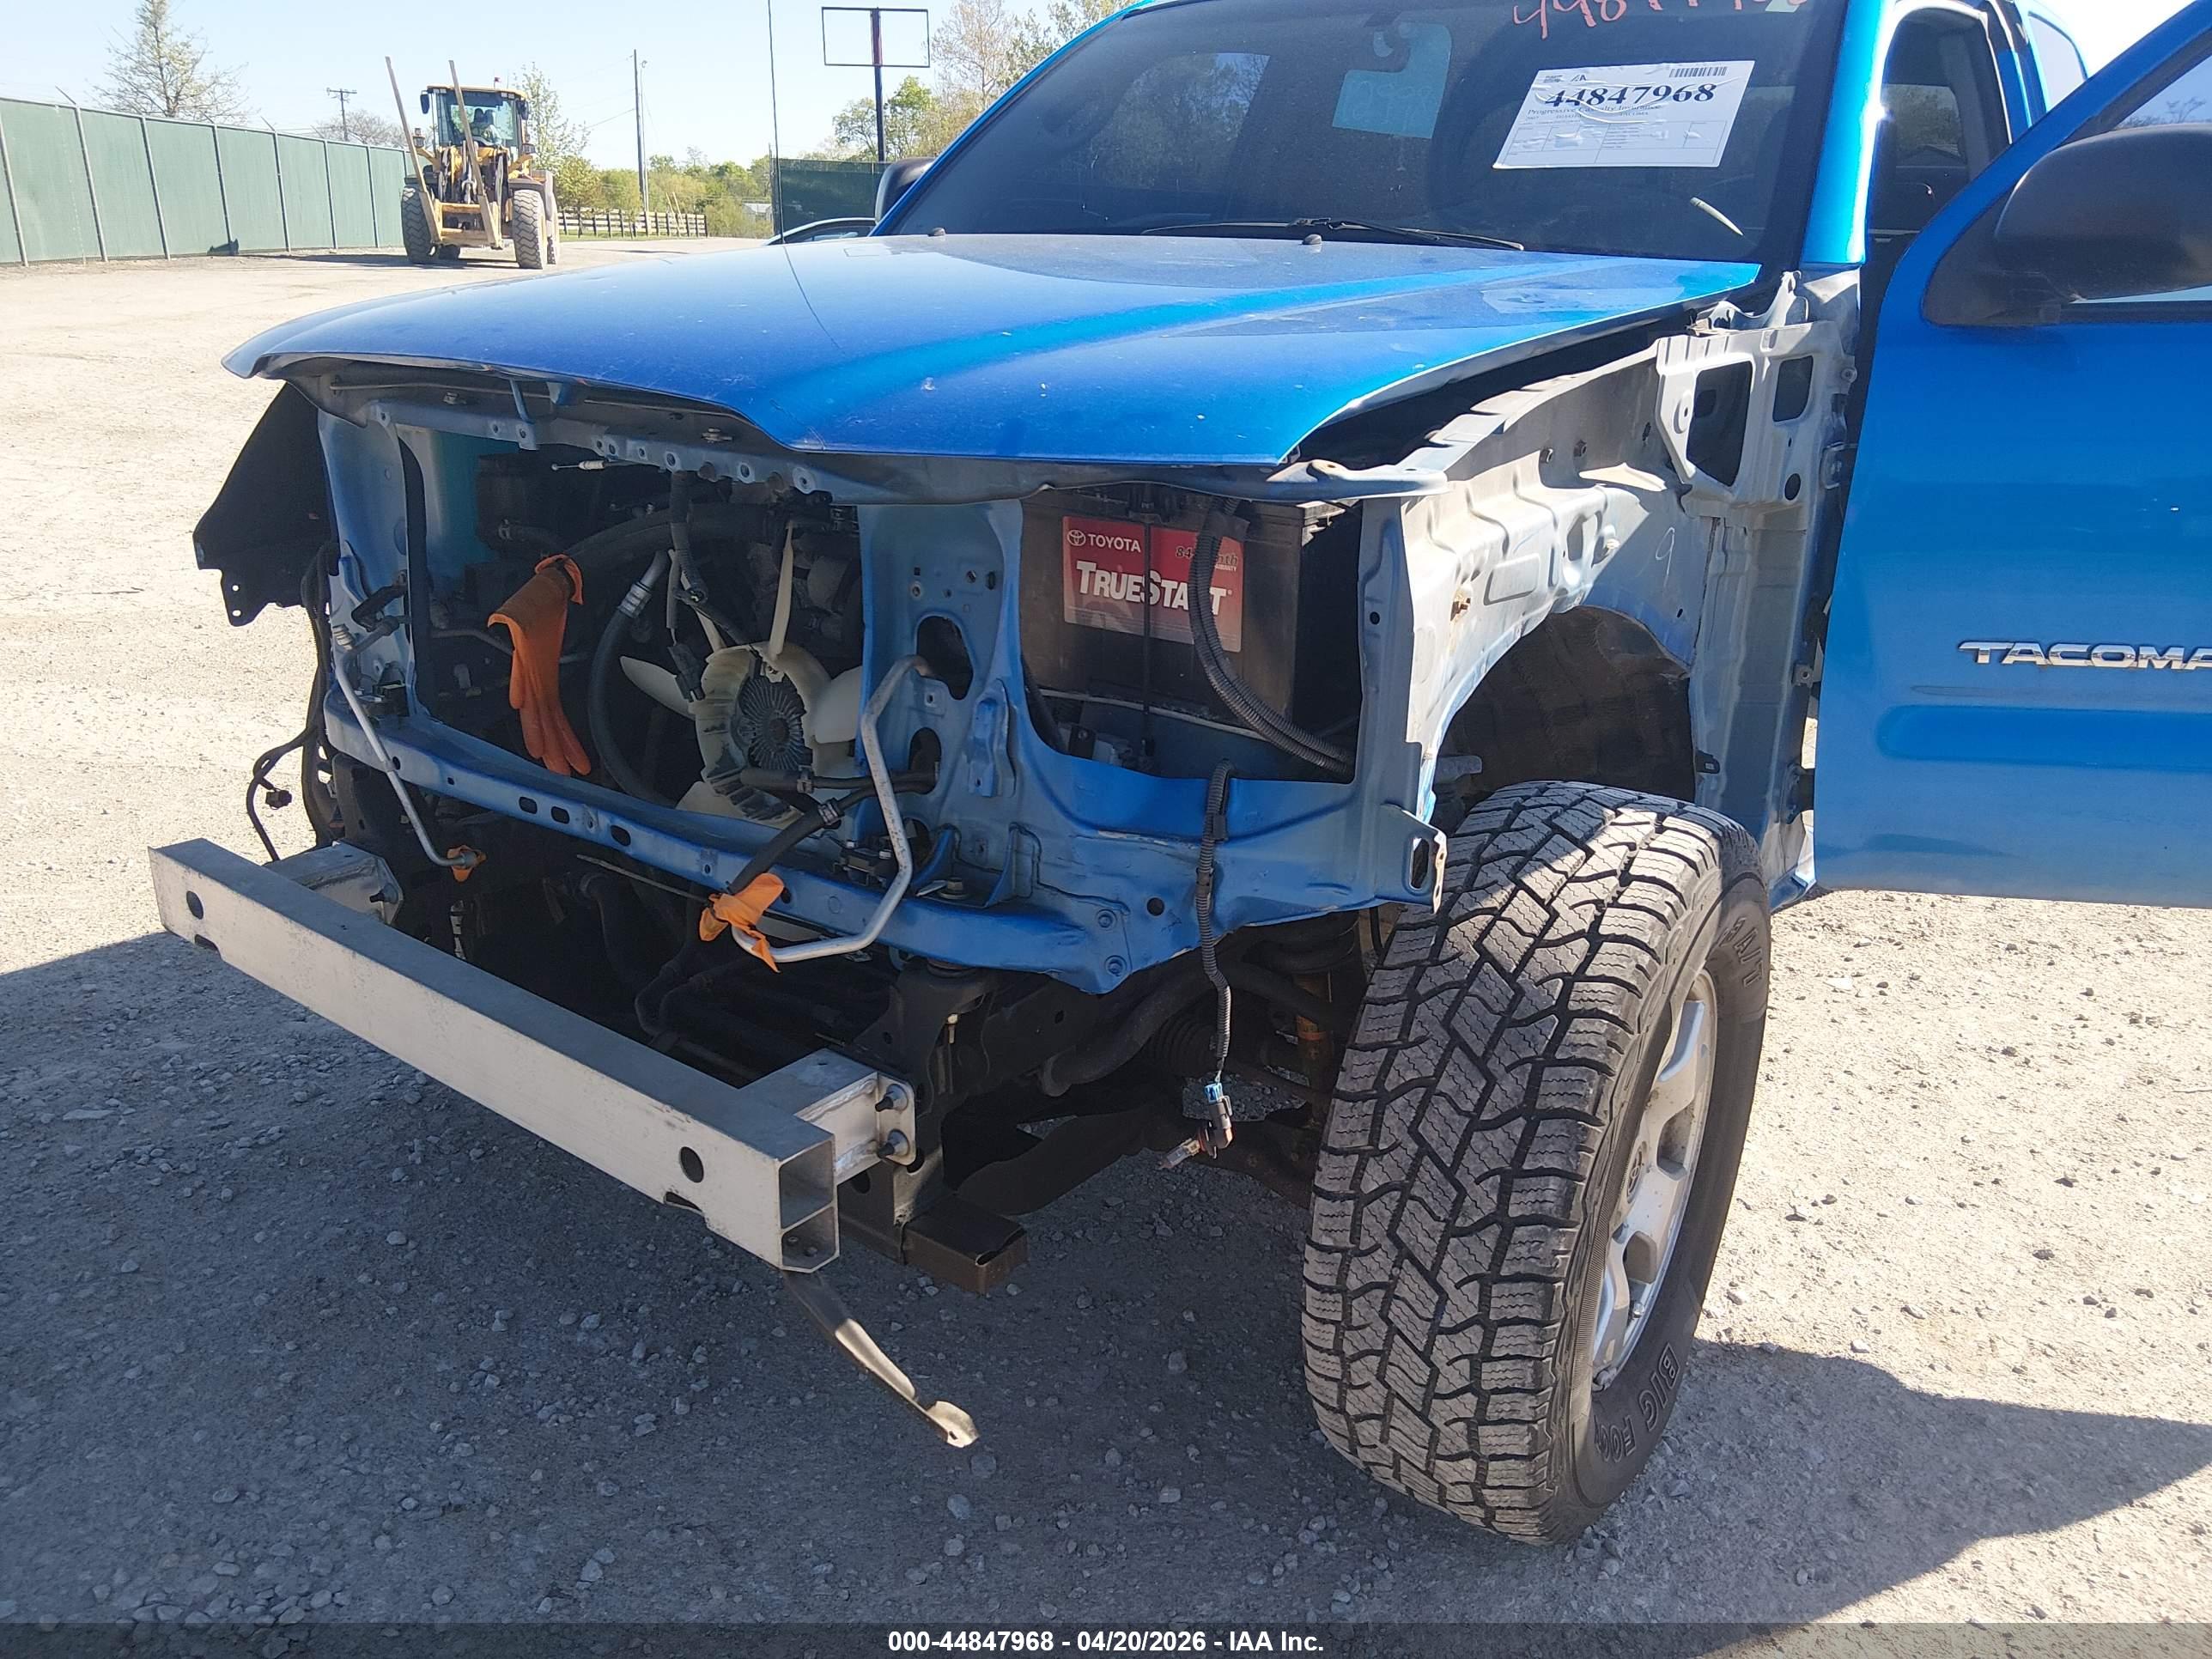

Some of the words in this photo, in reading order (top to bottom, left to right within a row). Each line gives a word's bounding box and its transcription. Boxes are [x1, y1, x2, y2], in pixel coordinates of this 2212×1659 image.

[1545, 82, 1717, 107] 44847968
[1088, 533, 1141, 553] TOYOTA
[1076, 560, 1227, 616] TRUESTAT
[1958, 641, 2212, 670] TACOMA
[1638, 1342, 1680, 1432] BIG
